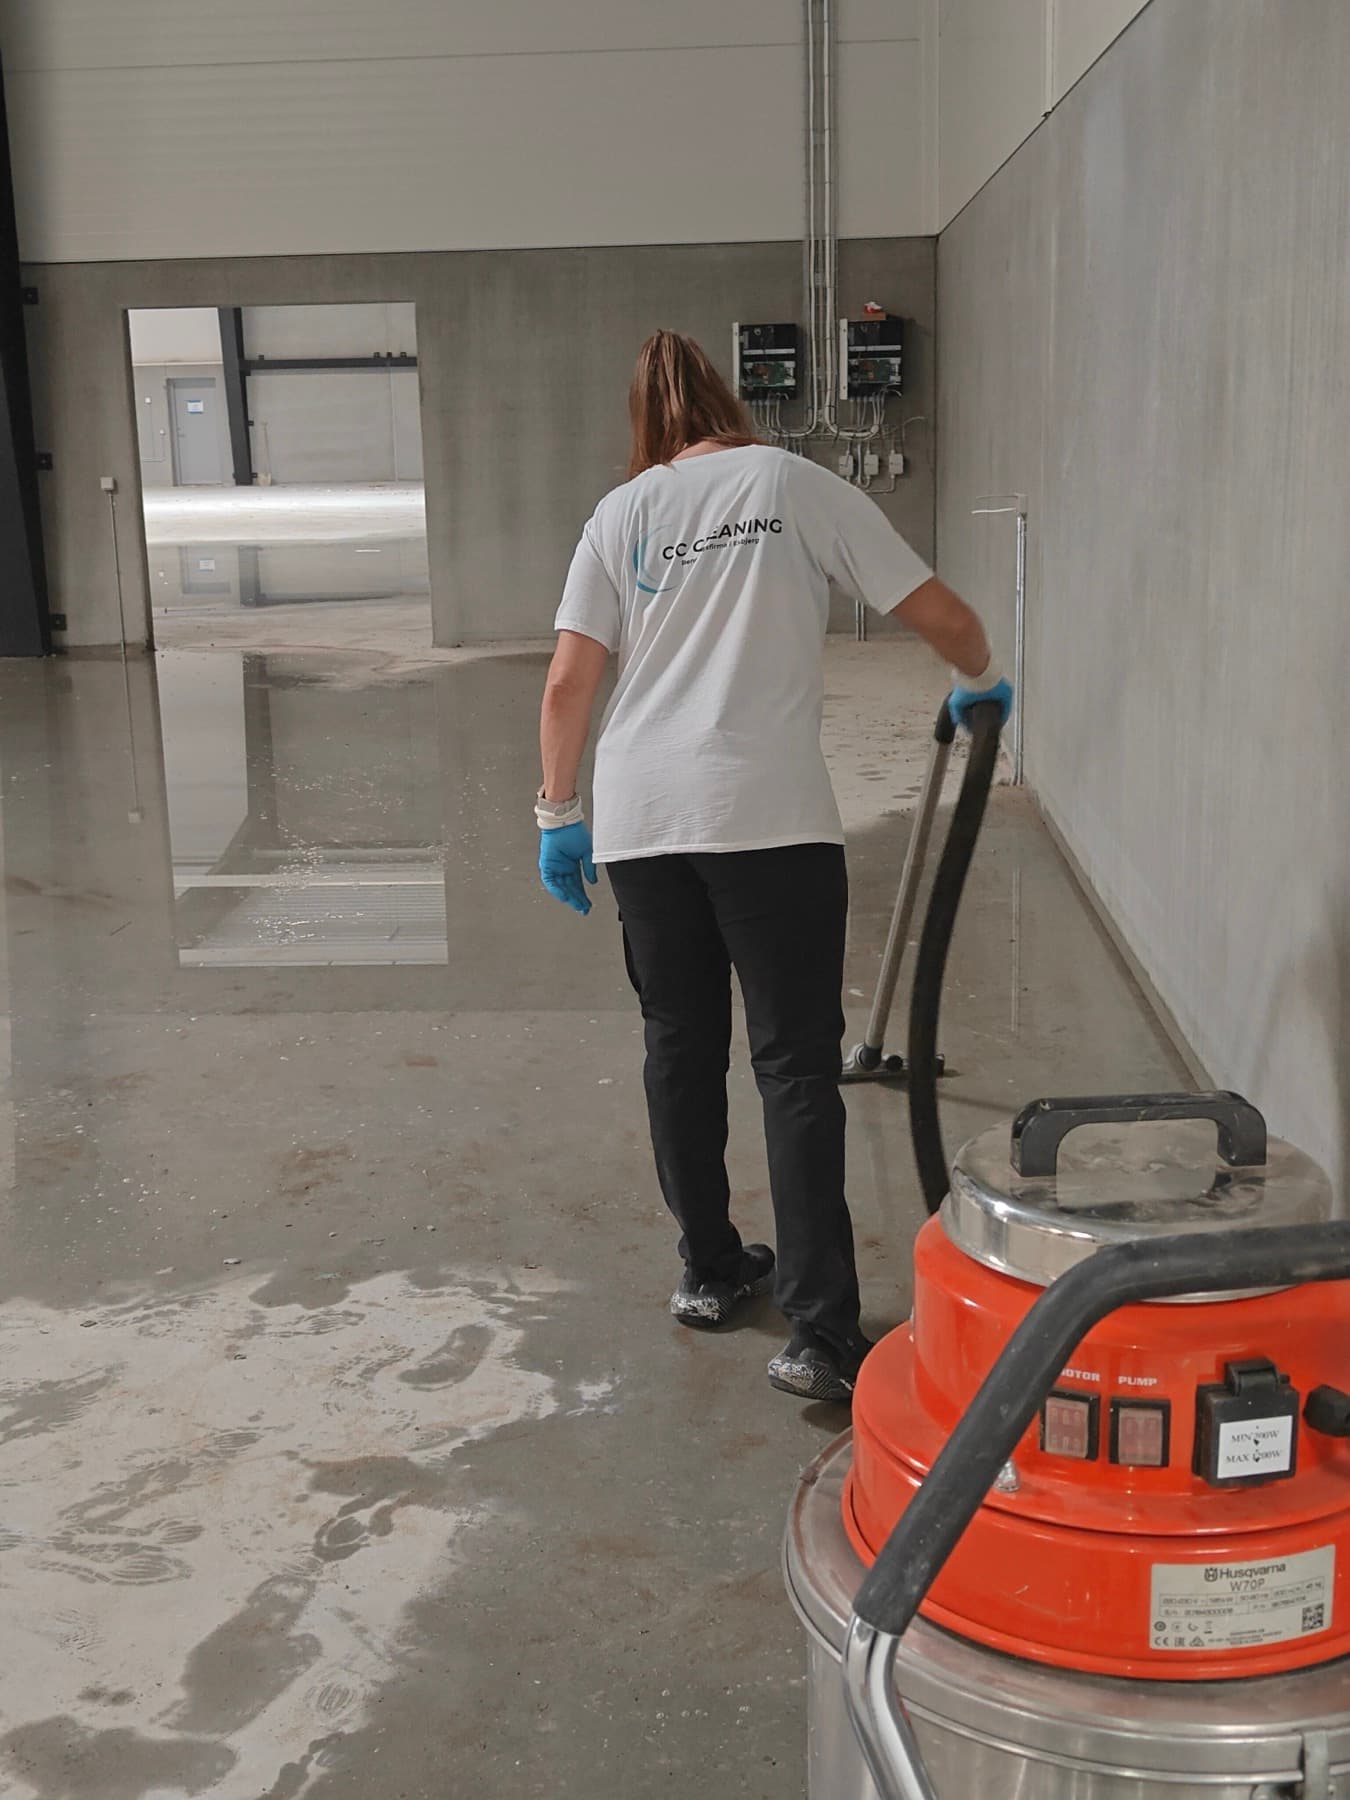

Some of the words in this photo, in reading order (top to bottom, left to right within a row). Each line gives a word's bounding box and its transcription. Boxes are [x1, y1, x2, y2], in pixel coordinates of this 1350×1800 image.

[662, 543, 687, 560] CC
[693, 518, 783, 552] CEANING
[1118, 1375, 1157, 1387] PUMP
[1232, 1433, 1252, 1443] MIN
[1226, 1453, 1250, 1463] MAX
[1219, 1563, 1286, 1579] Husqvarna
[1230, 1577, 1265, 1592] W70P
